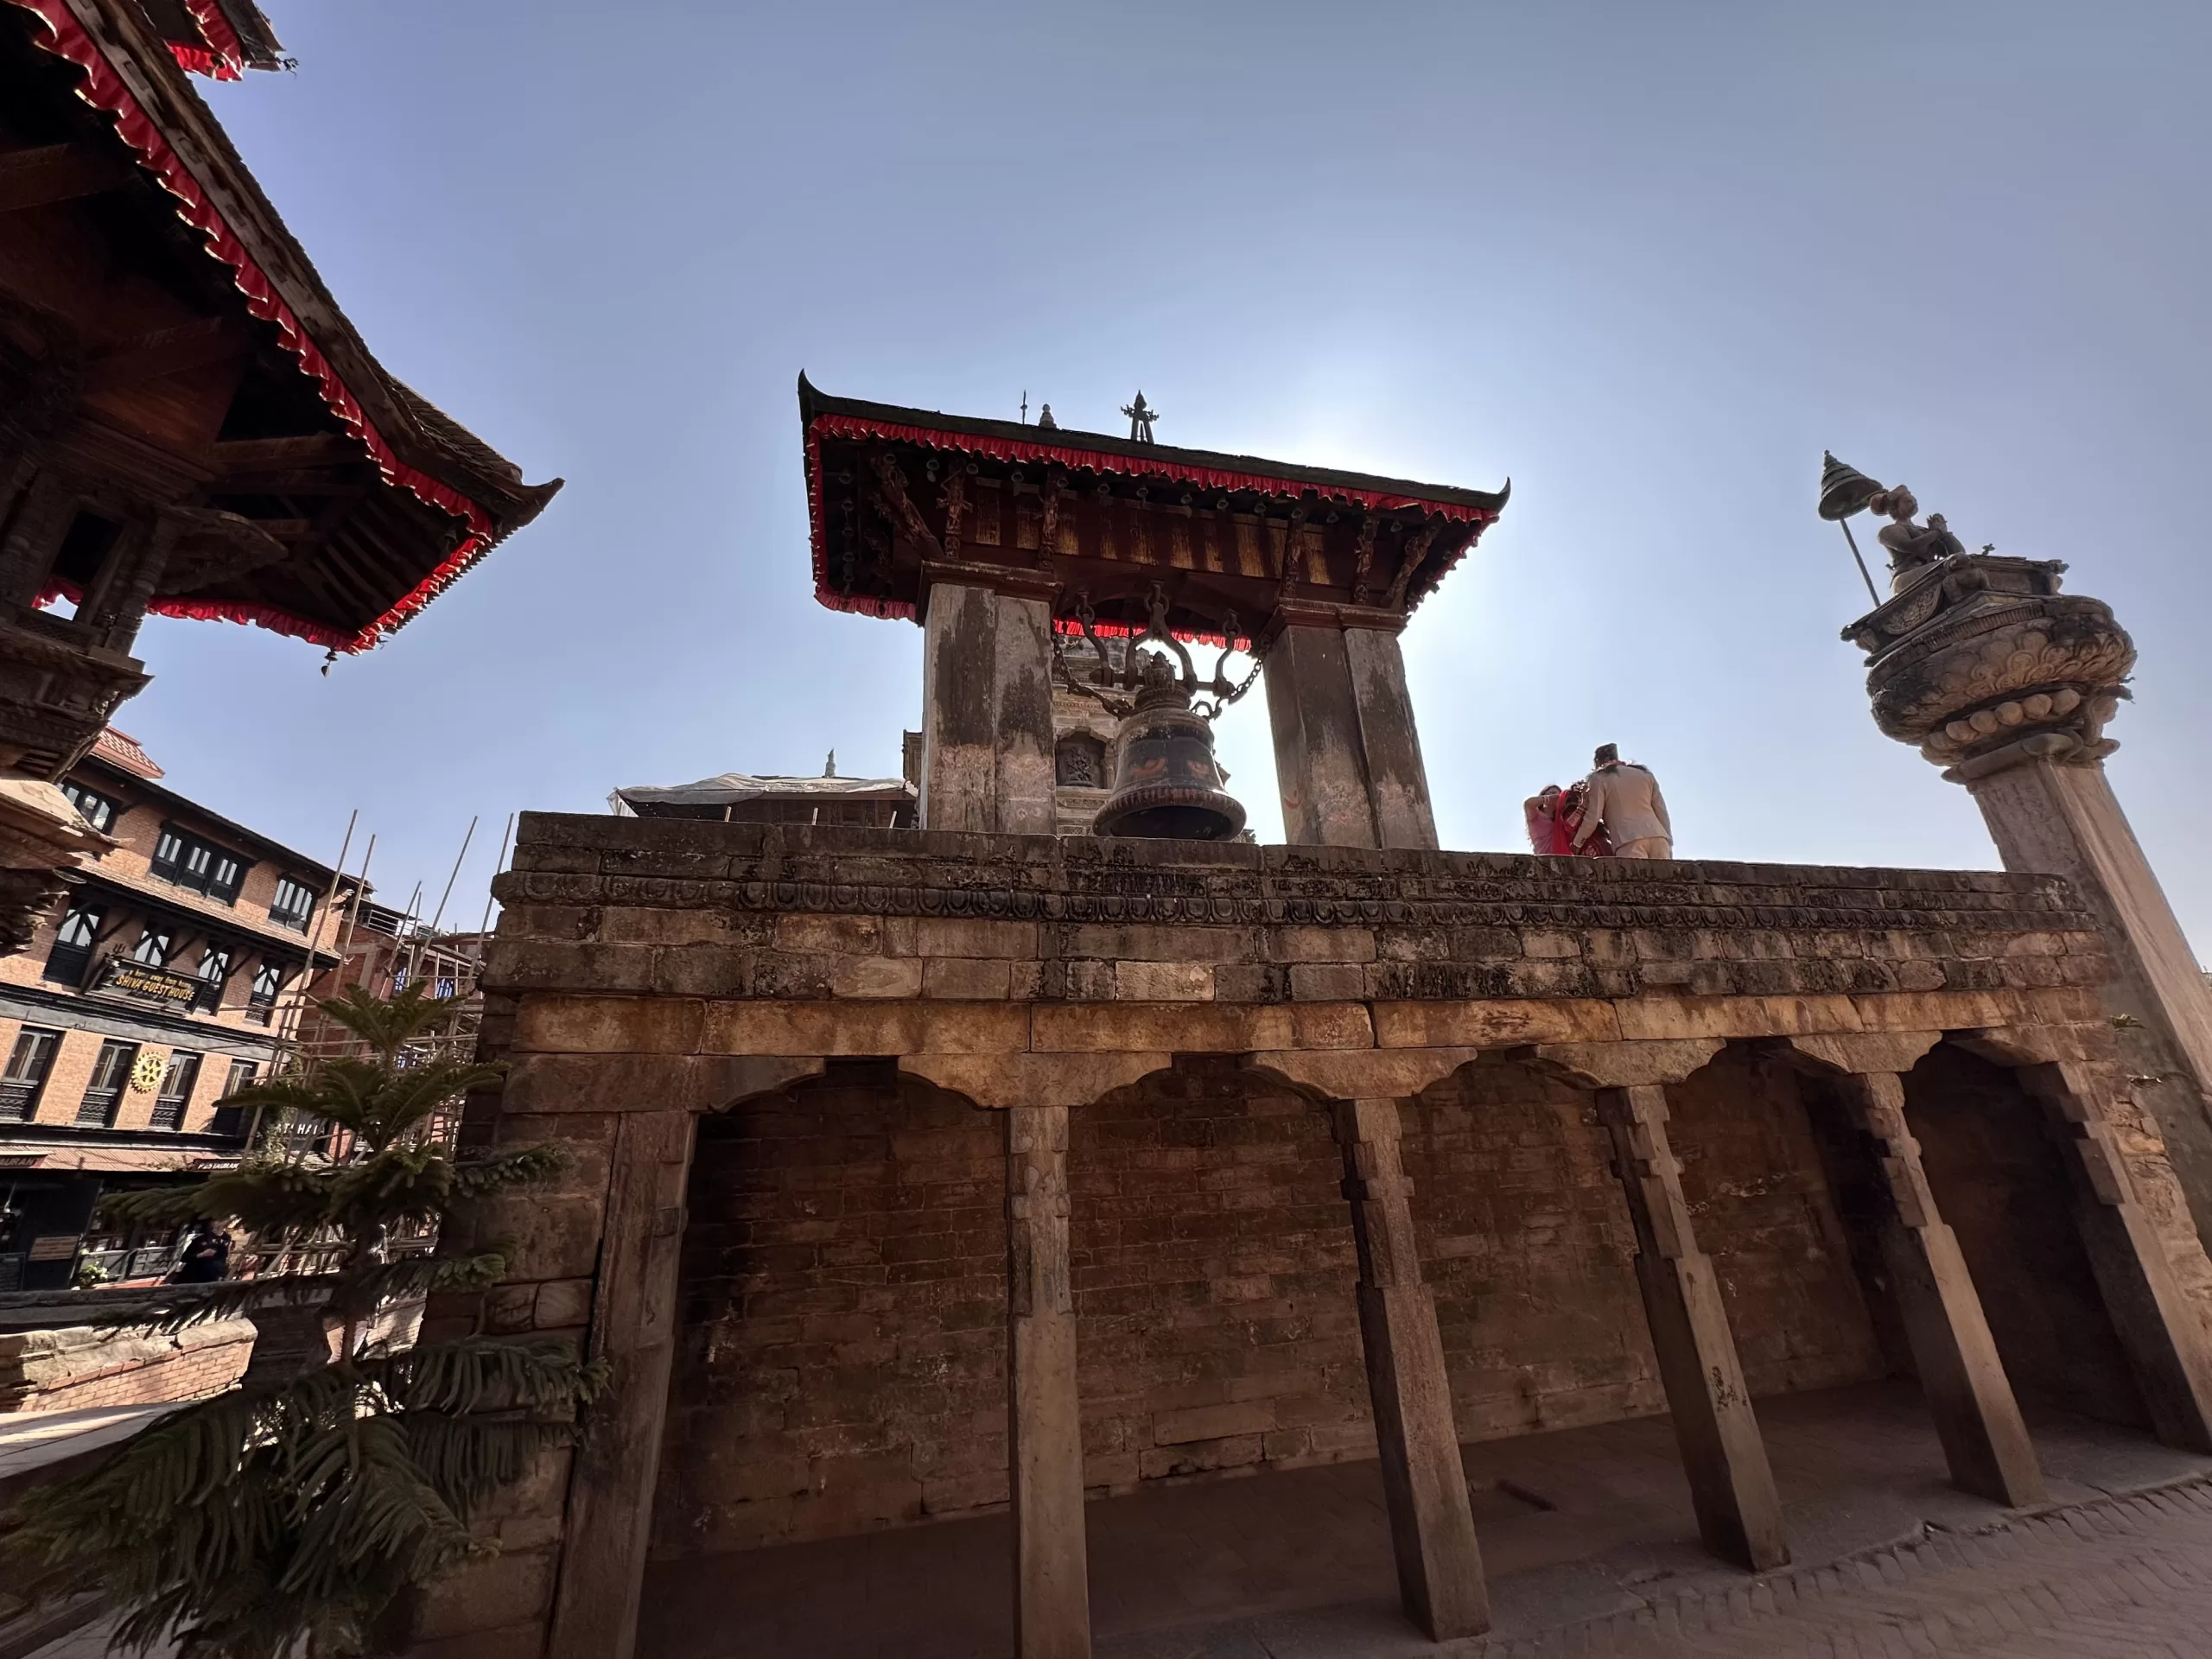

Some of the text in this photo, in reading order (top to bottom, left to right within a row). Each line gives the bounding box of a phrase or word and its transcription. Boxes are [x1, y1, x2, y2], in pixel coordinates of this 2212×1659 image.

[116, 975, 195, 1001] SHIVA GUEST HOUSE
